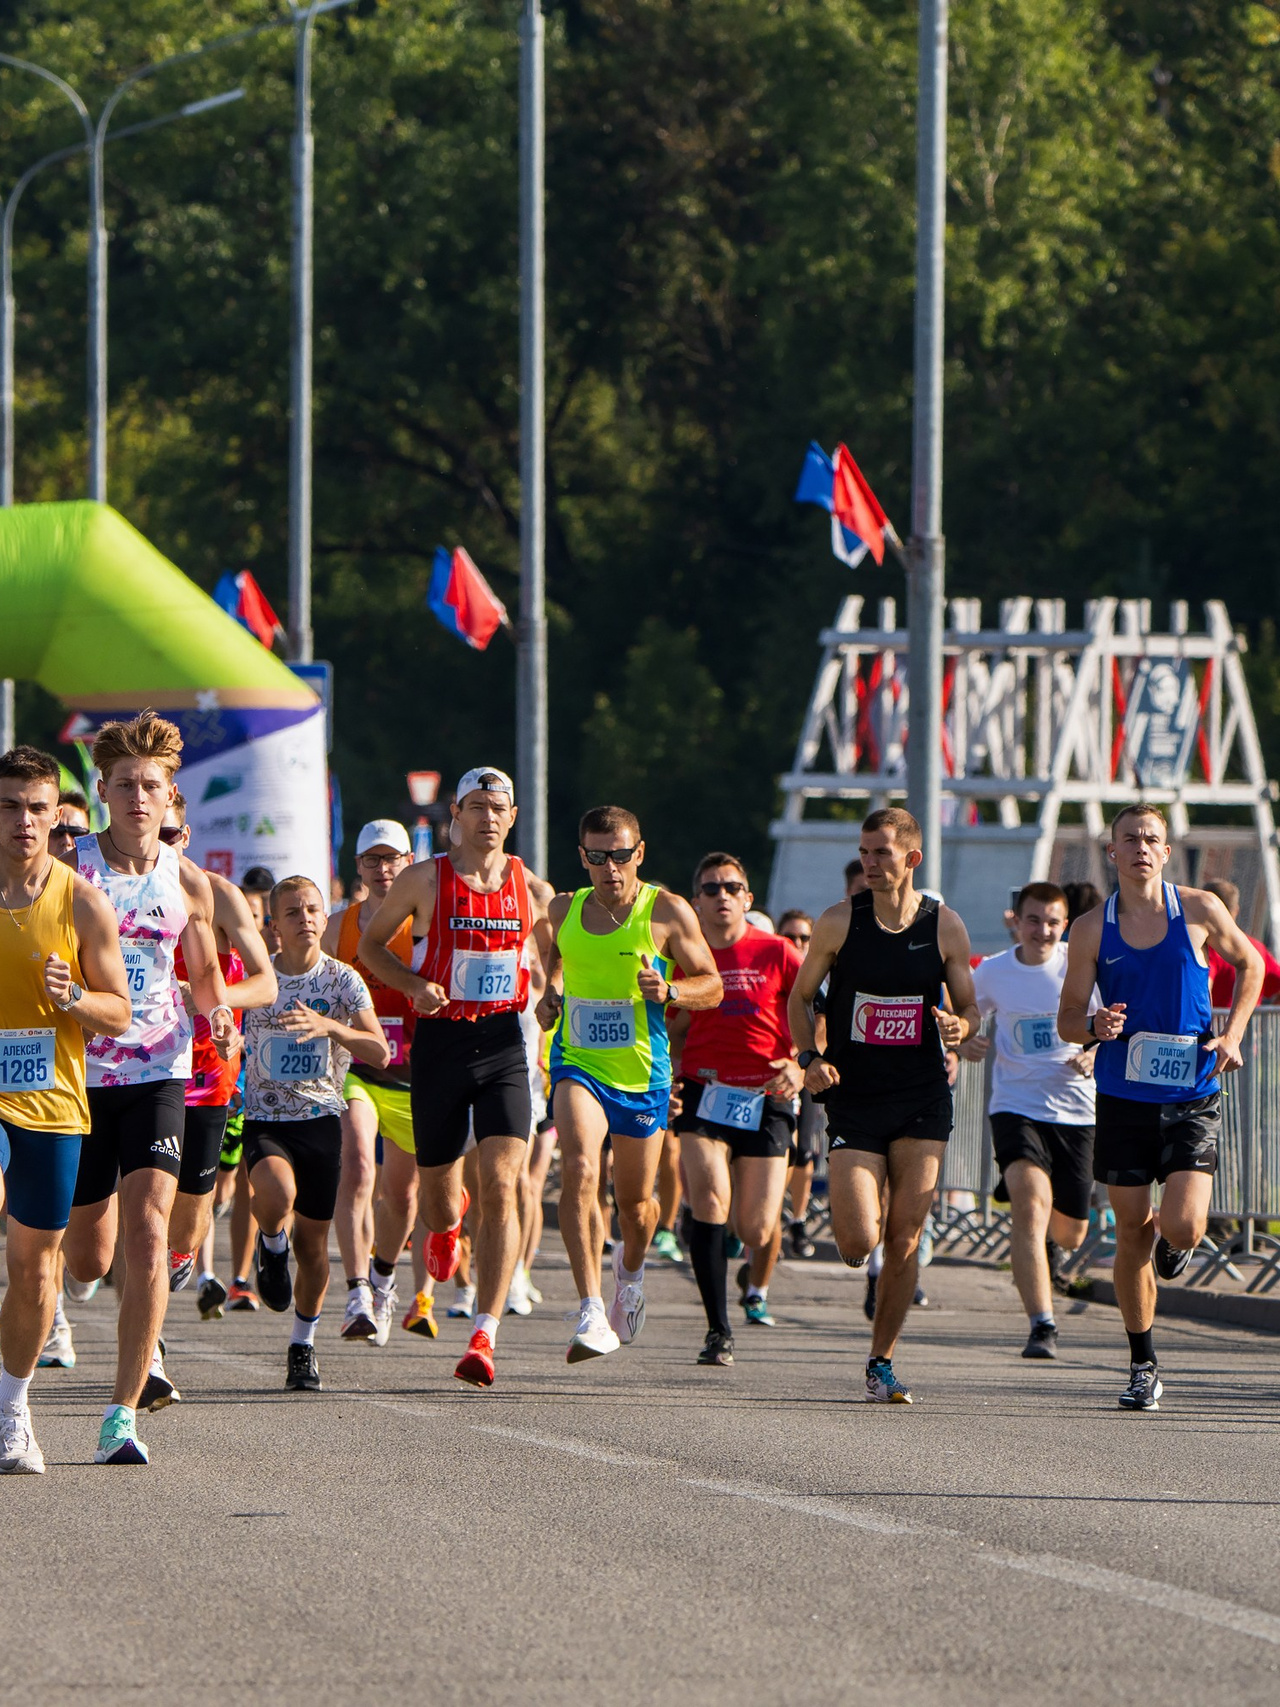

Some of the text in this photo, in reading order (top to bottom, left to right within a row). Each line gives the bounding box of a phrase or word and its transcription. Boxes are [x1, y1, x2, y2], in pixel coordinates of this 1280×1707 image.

[452, 918, 520, 930] PRO NINE
[484, 964, 505, 974] ДЕНИС
[477, 974, 511, 995] 1372
[593, 1011, 622, 1022] АНДРЕЙ
[875, 1008, 917, 1019] АЛЕКСАНДР
[588, 1023, 630, 1043] 3559
[874, 1020, 916, 1040] 4224
[3, 1042, 42, 1056] АЛЕКСЕЙ
[287, 1043, 316, 1053] МАТВЕЙ
[1033, 1031, 1052, 1049] 60
[1157, 1046, 1186, 1058] ПЛАТОН
[0, 1057, 48, 1084] 1285
[280, 1055, 322, 1075] 2297
[1149, 1058, 1191, 1080] 3467
[724, 1102, 752, 1124] 728
